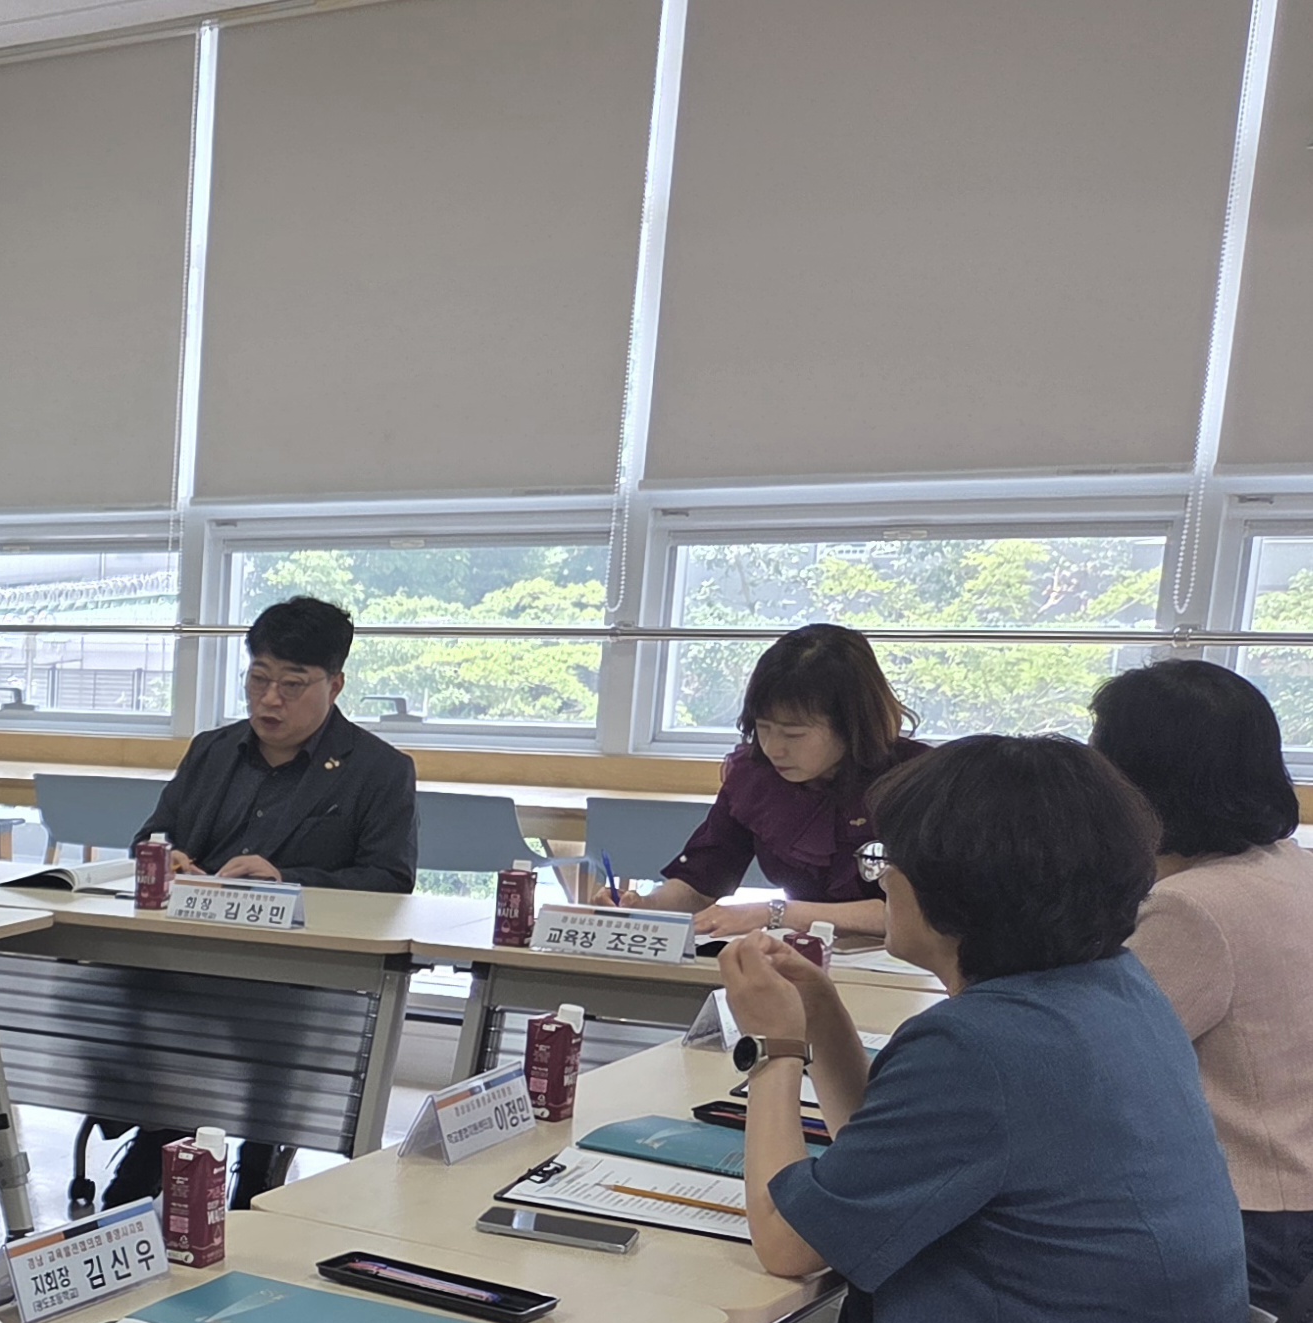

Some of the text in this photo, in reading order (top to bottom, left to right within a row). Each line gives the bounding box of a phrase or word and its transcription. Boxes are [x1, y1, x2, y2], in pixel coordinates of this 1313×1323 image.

[185, 896, 285, 925] 회장 김상민
[561, 916, 660, 933] 경상남도통영교육지원청
[546, 927, 669, 957] 교육장 조은주
[494, 1095, 531, 1131] 이정민
[27, 1255, 44, 1270] 경남
[105, 1221, 145, 1242] 통영시지회
[31, 1239, 155, 1296] 지회장 김신우
